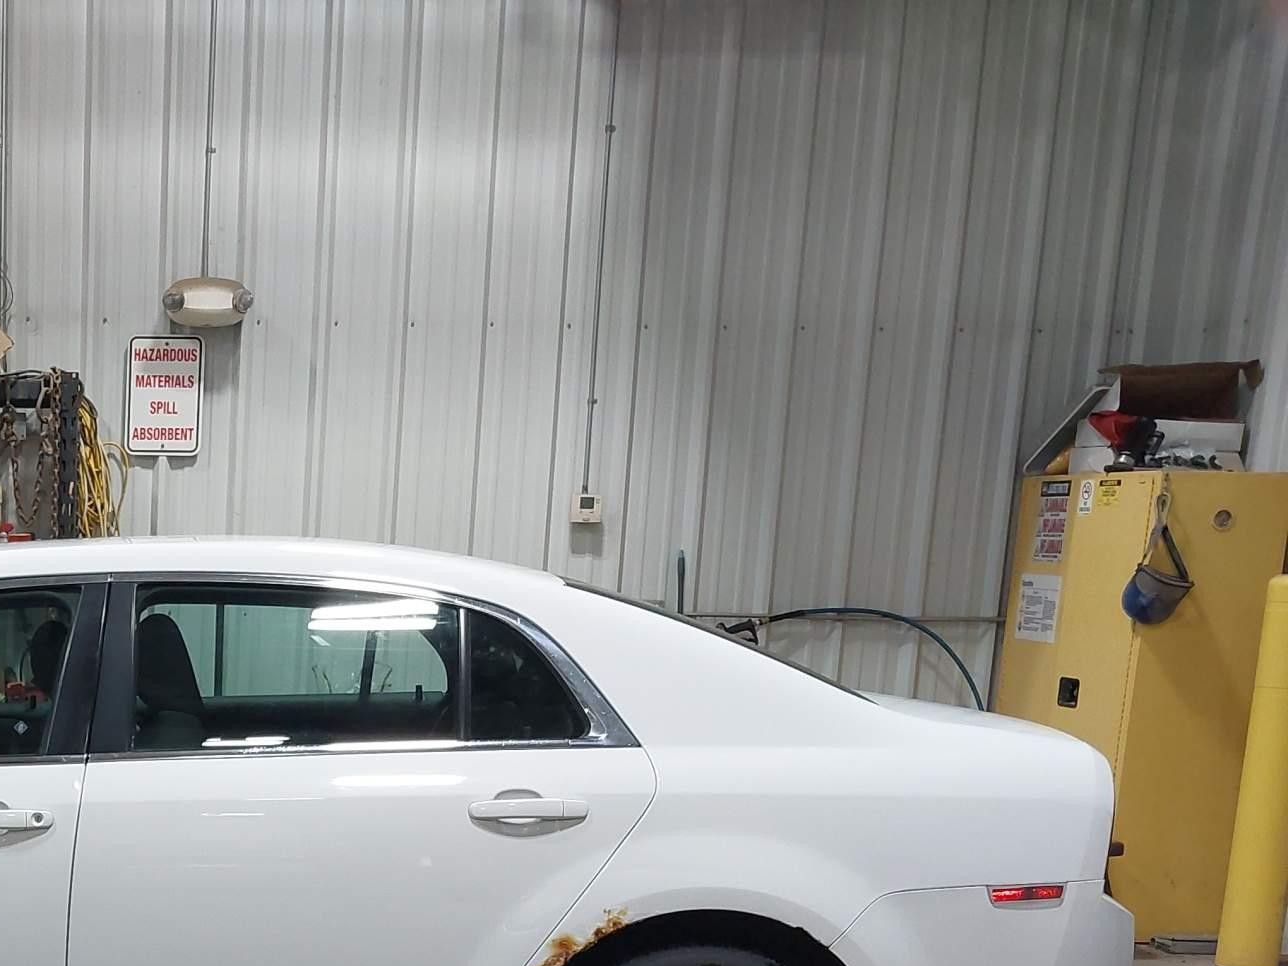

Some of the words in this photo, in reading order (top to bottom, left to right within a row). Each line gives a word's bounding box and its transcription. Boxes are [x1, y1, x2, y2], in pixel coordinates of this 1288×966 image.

[133, 347, 198, 362] HAZARDOUS
[135, 374, 195, 389] MATERIALS
[149, 400, 178, 415] SPILL
[131, 427, 195, 441] ABSORBENT
